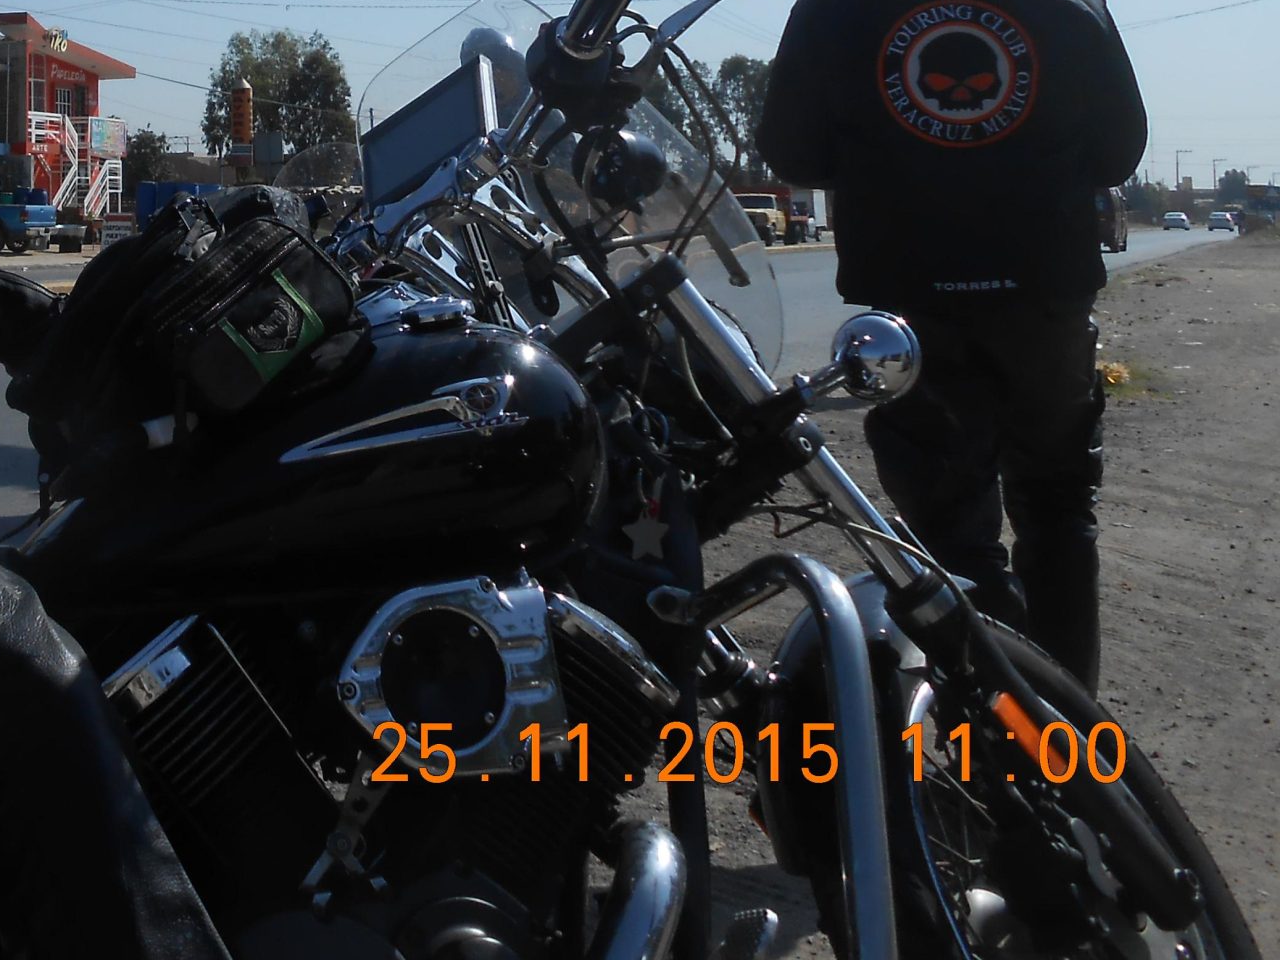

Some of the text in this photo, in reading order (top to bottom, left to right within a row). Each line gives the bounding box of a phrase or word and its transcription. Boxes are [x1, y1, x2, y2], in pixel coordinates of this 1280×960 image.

[885, 4, 1027, 57] TOURING CLUB
[885, 71, 1031, 141] VERACRUZ MEXICO
[933, 280, 1001, 291] TORRES
